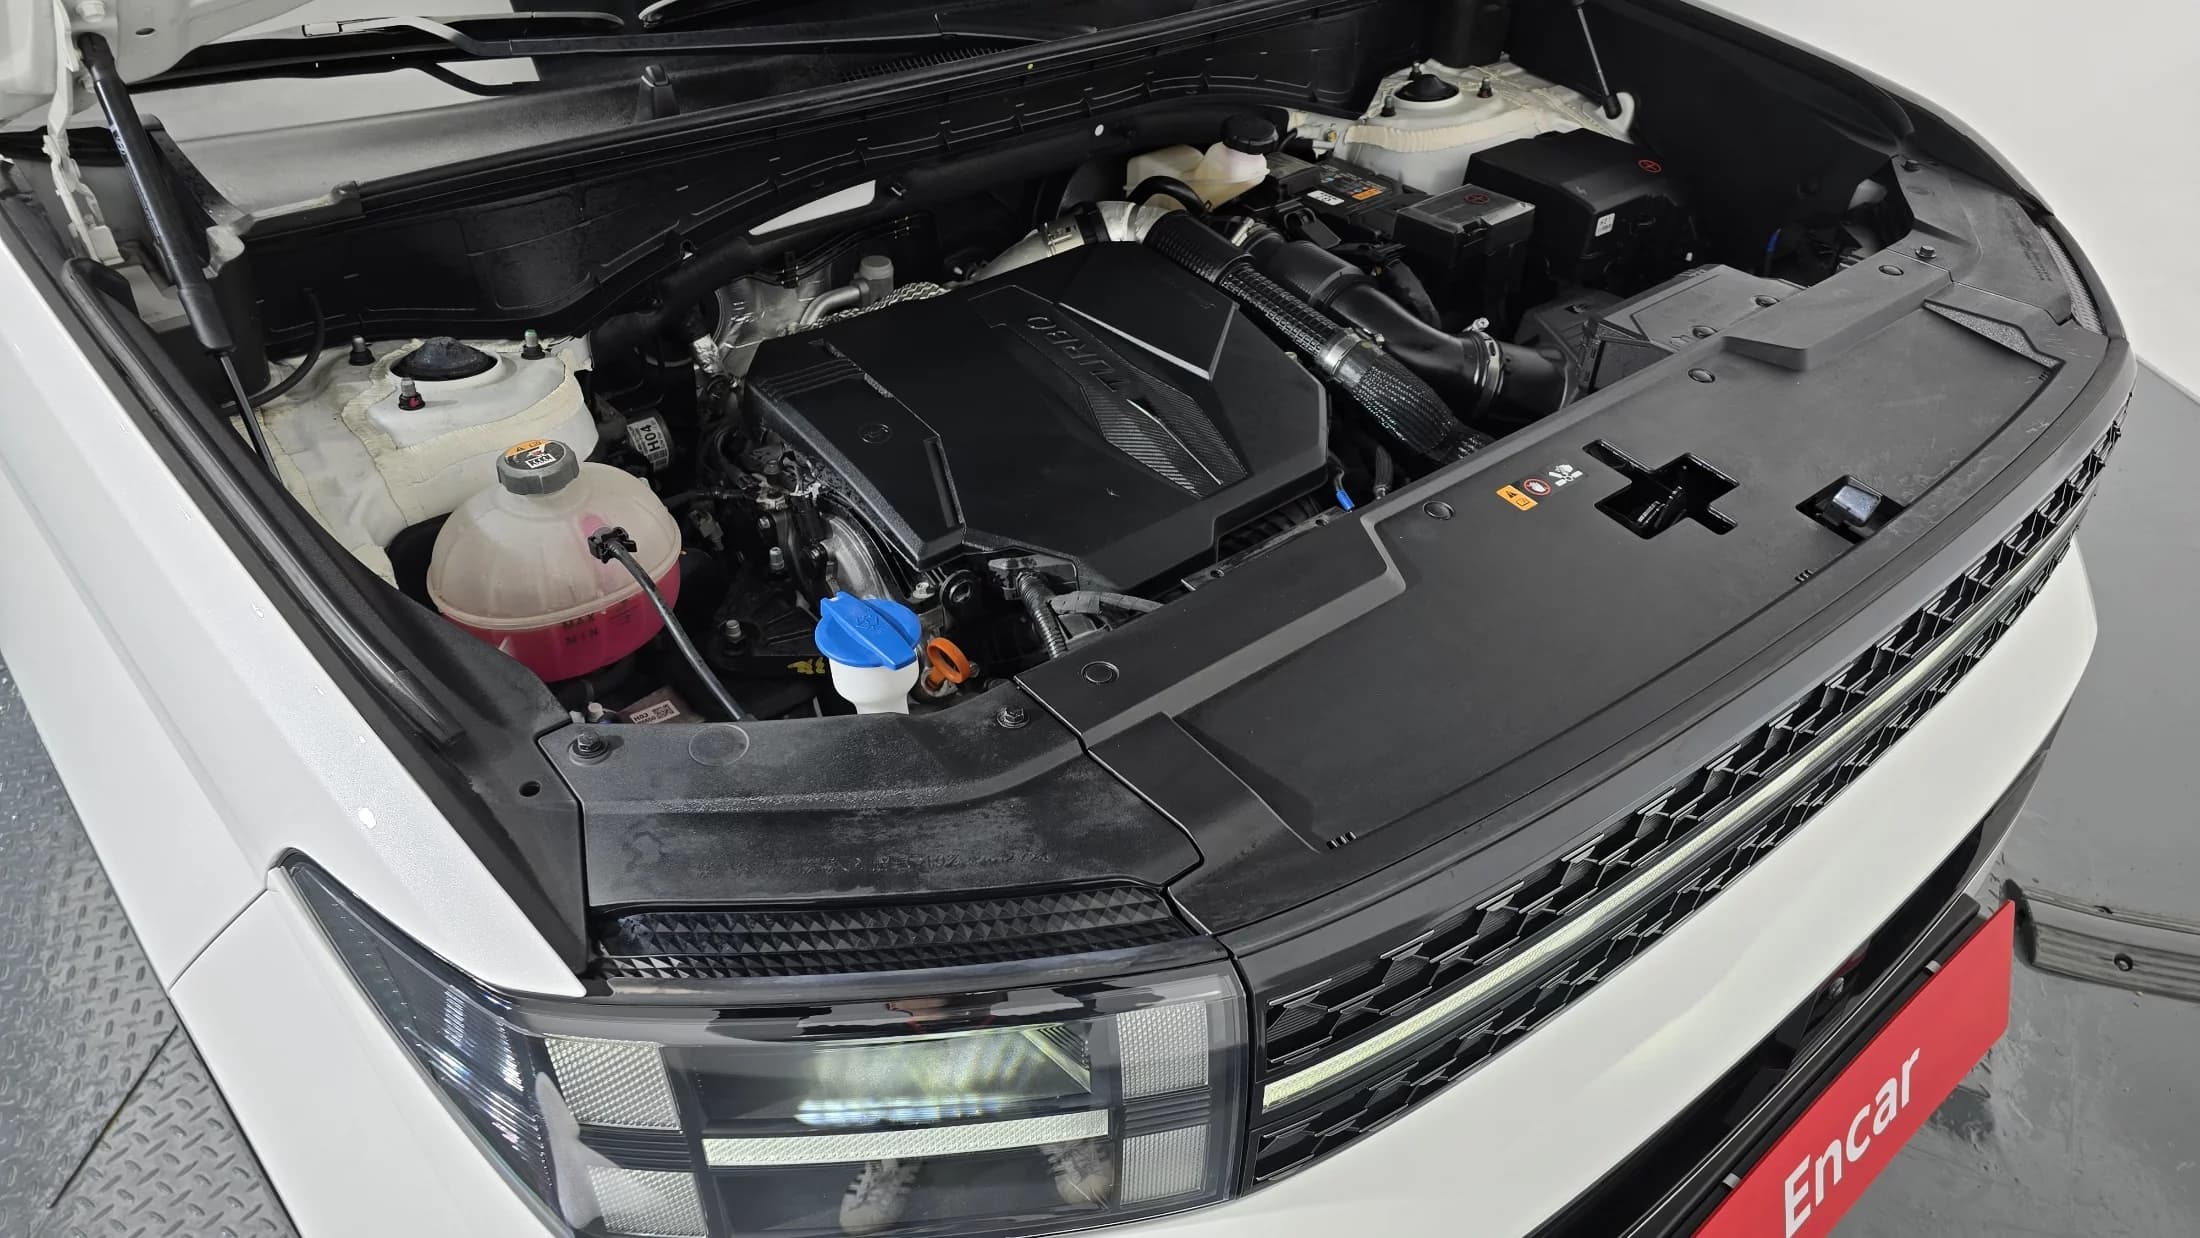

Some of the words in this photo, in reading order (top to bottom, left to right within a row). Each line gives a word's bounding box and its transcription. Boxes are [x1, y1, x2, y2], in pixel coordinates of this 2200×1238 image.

[1025, 316, 1131, 393] TURBO
[640, 423, 661, 452] H04
[1784, 1047, 1920, 1238] Encar
